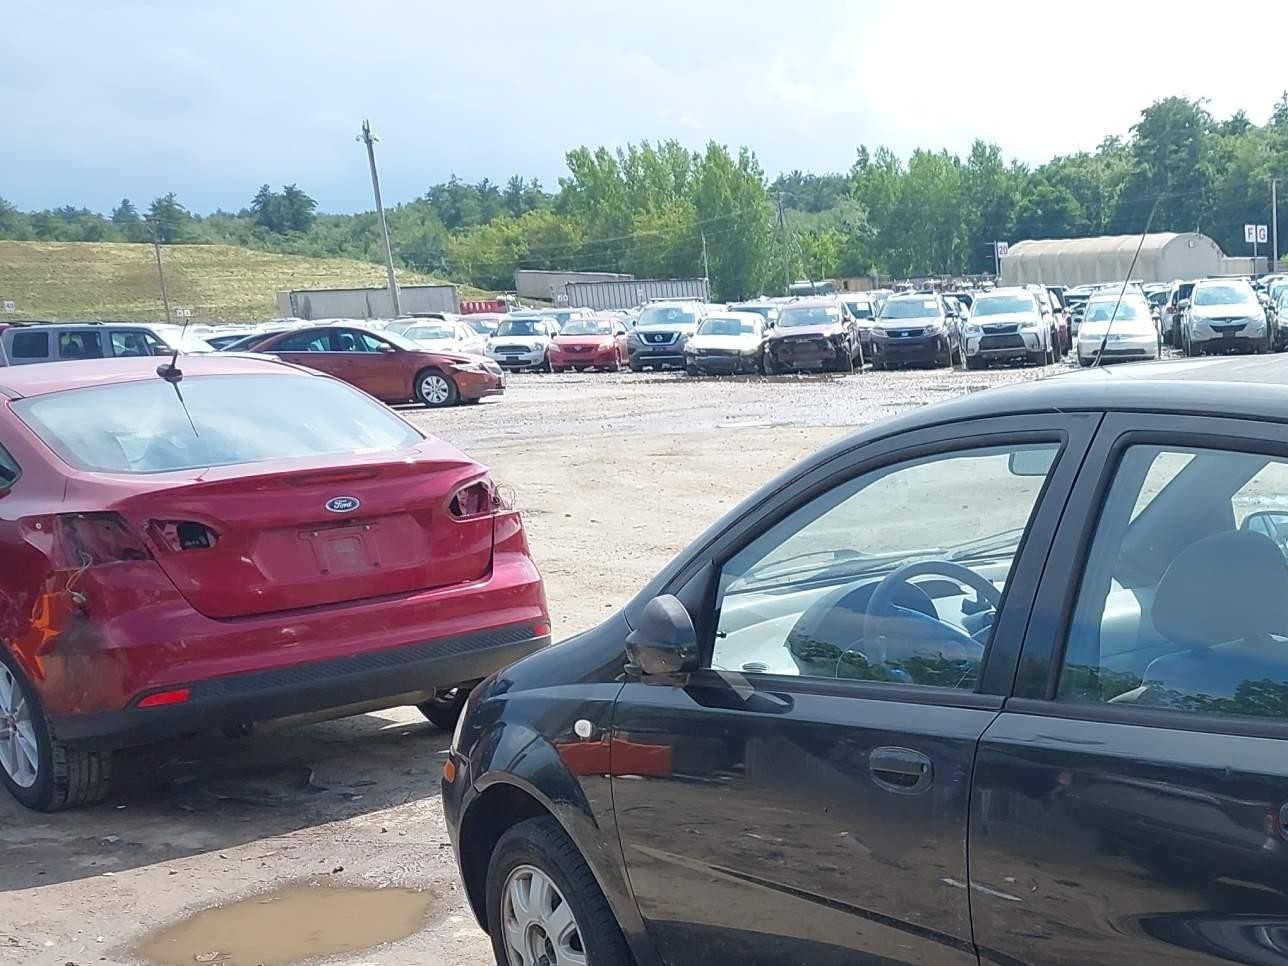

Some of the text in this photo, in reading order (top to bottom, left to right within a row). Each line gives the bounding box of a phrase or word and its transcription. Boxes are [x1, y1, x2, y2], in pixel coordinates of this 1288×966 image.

[1248, 227, 1254, 240] F
[1259, 227, 1266, 240] G
[999, 246, 1008, 255] 20
